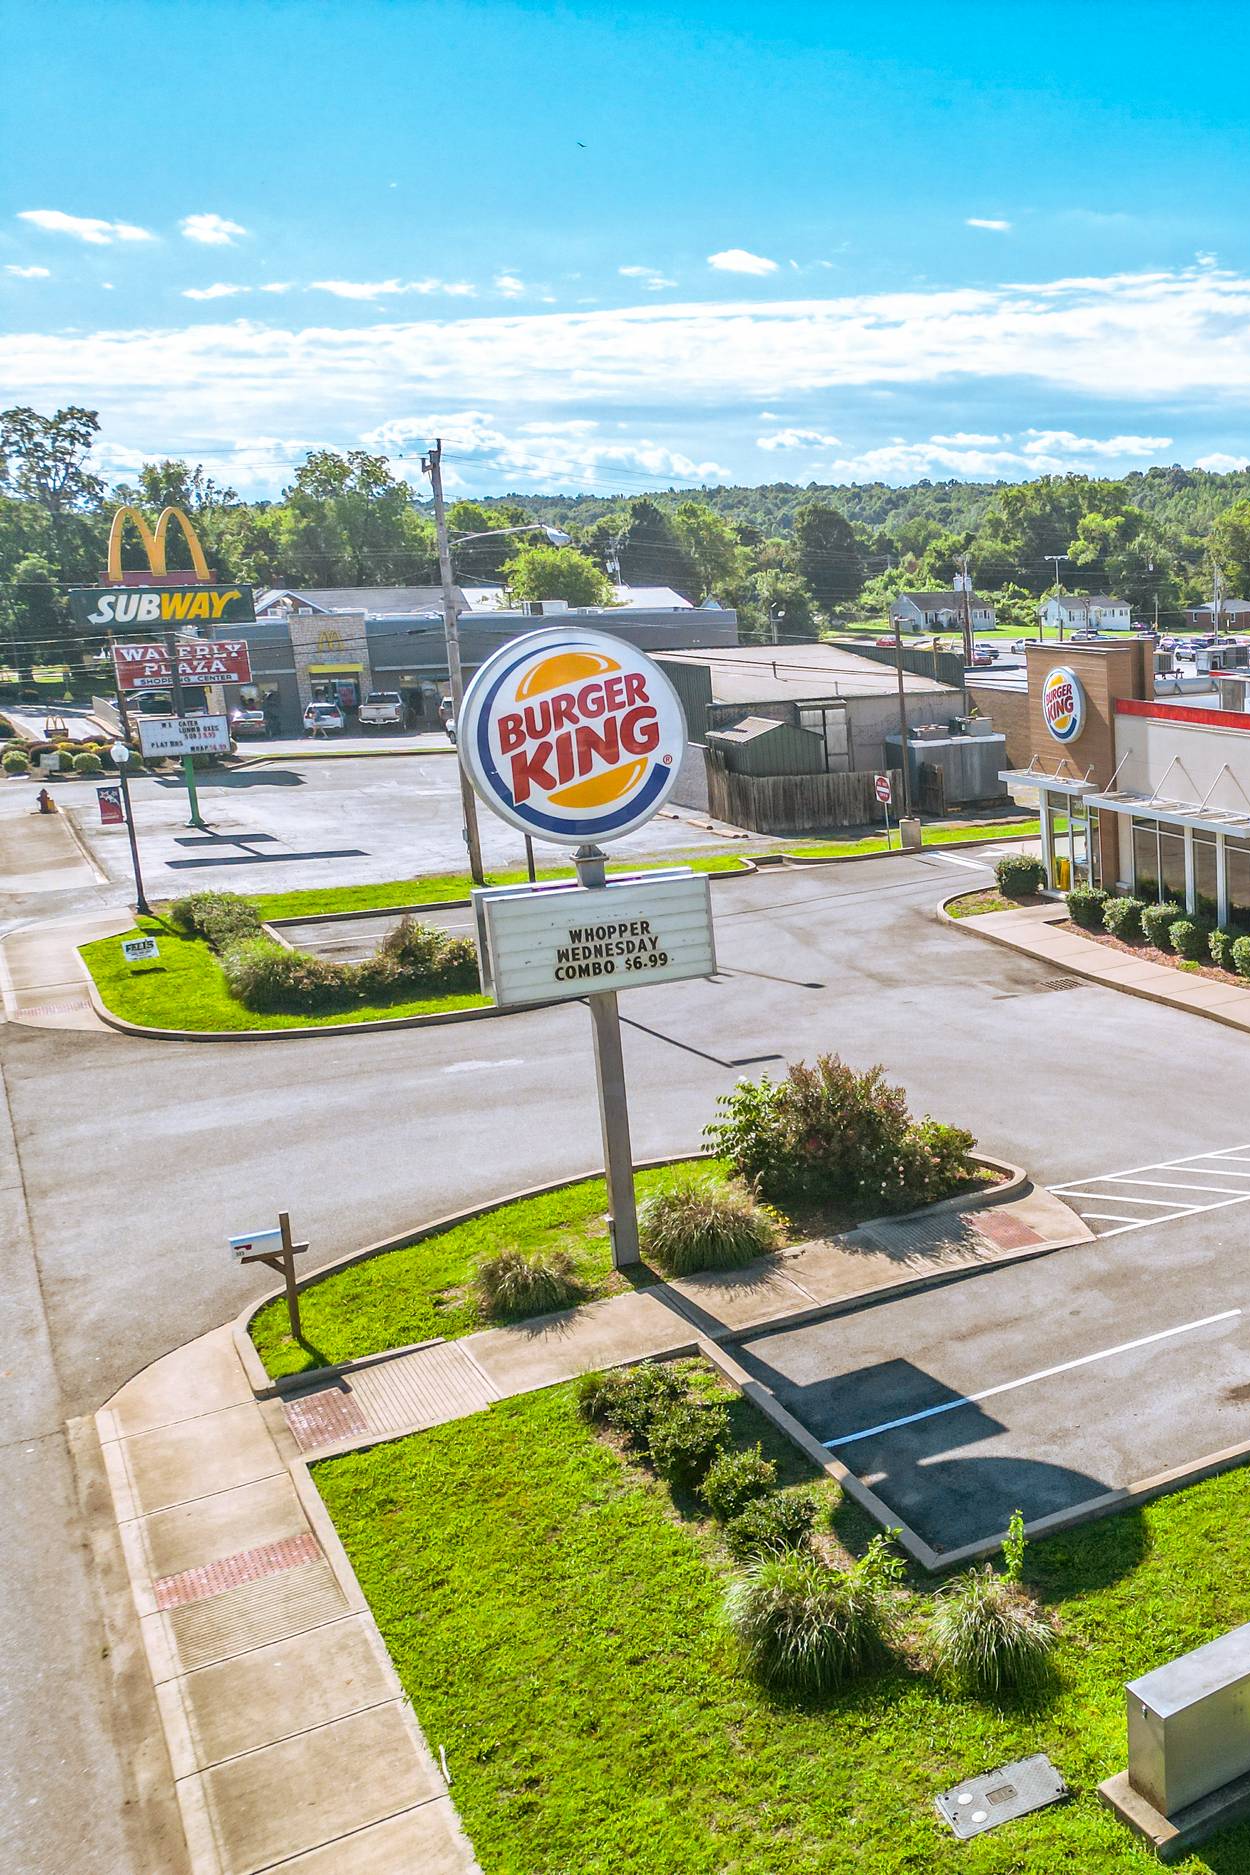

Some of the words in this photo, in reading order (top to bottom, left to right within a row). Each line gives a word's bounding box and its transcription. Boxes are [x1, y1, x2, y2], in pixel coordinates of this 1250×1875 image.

[87, 589, 242, 624] SUBWAY
[143, 660, 228, 675] PLAZA
[197, 674, 233, 682] CENTER
[1046, 684, 1073, 706] BURGER
[498, 672, 650, 755] BURGER
[1047, 696, 1074, 721] KING
[510, 706, 660, 804] KING
[569, 920, 651, 944] WHOPPER
[557, 936, 659, 963] WEDNESDAY
[554, 959, 616, 981] COMBO
[625, 952, 669, 971] $6.99
